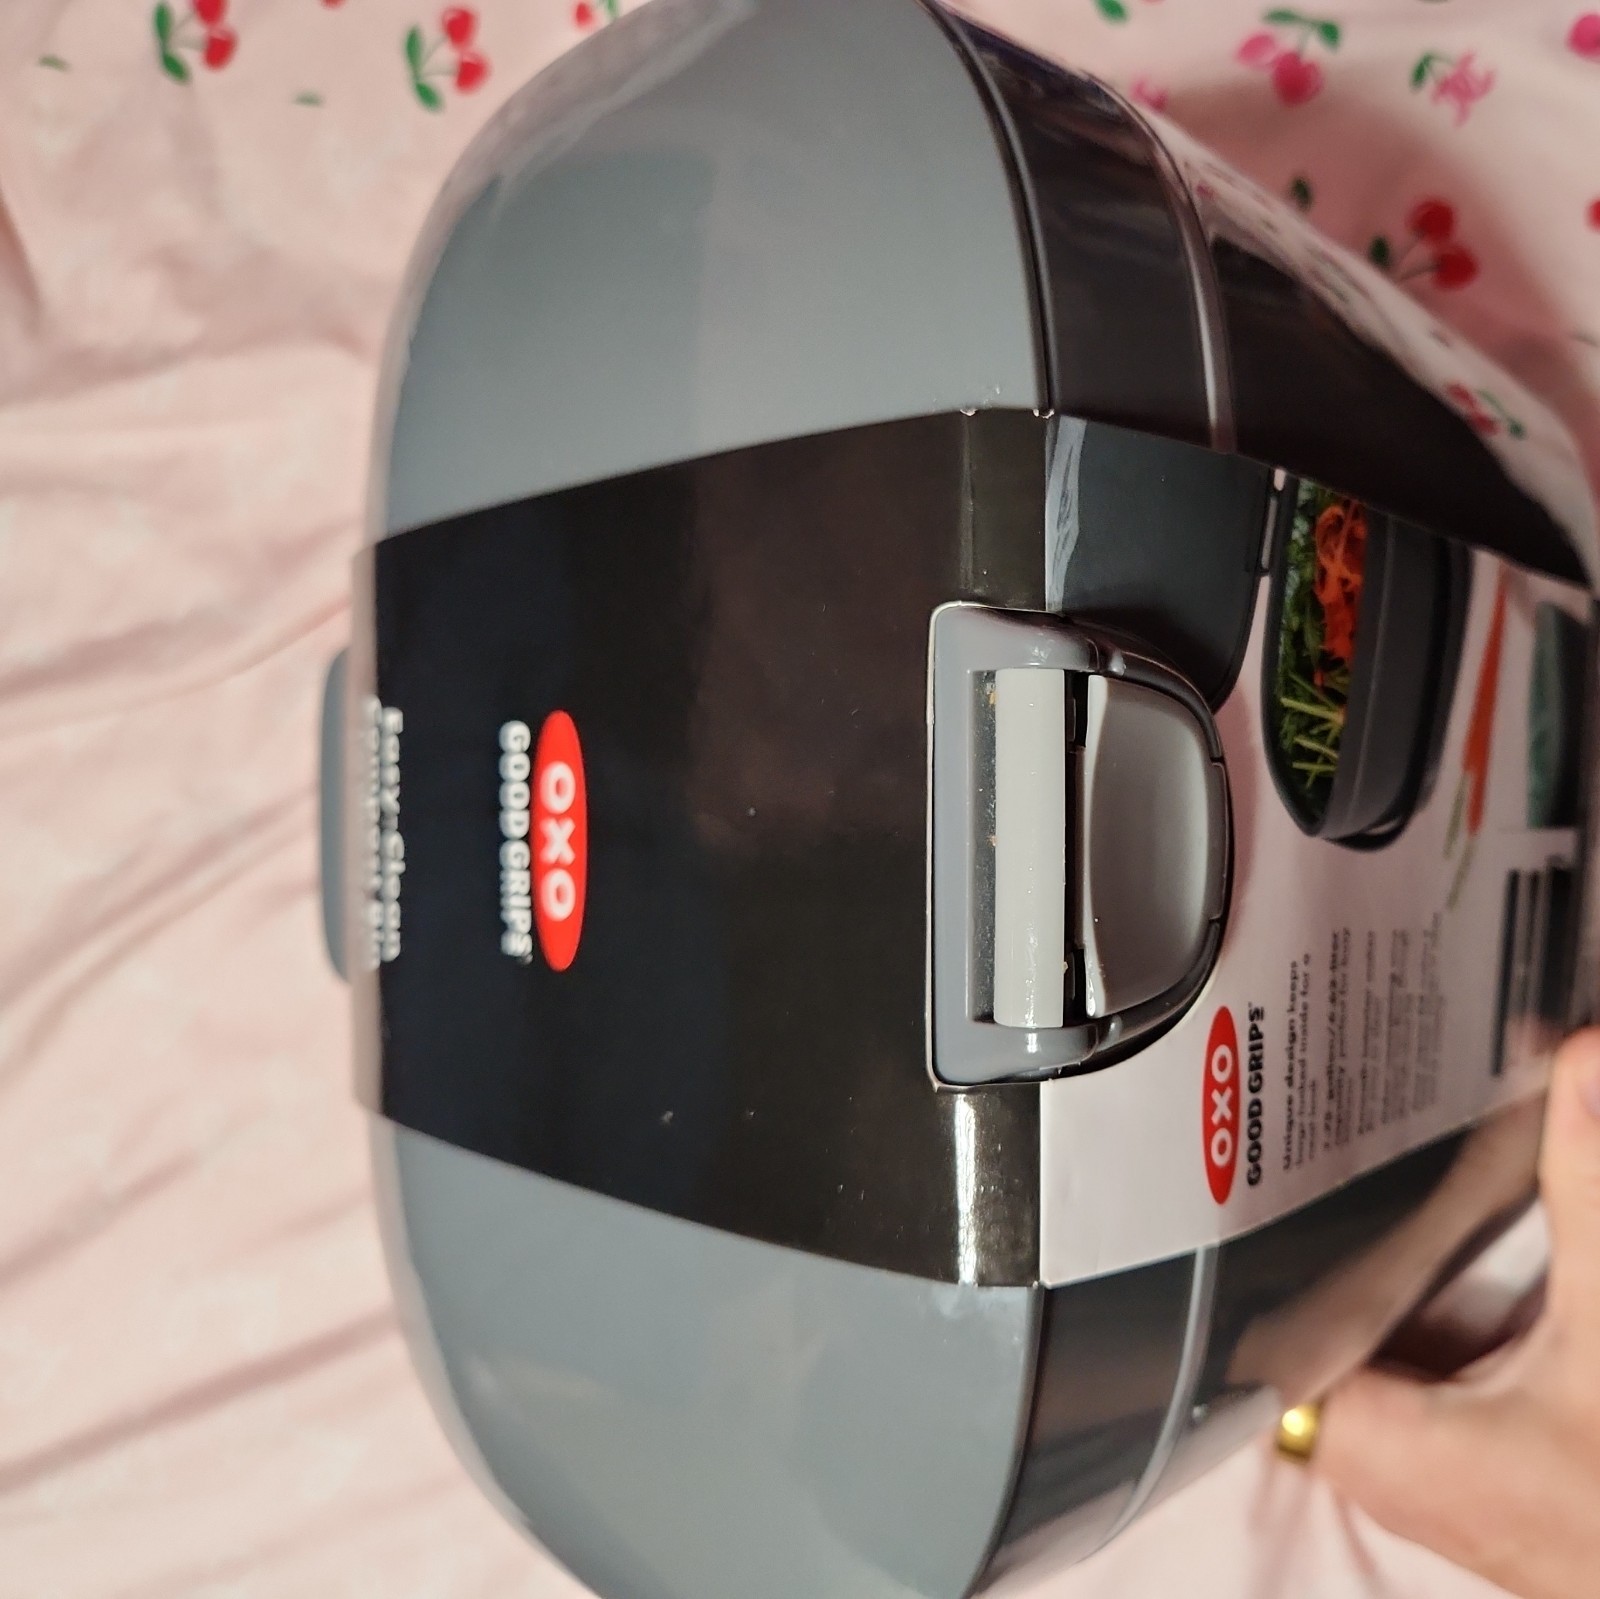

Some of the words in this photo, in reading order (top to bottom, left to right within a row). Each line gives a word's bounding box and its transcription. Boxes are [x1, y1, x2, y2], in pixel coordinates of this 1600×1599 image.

[380, 706, 406, 962] Easy-Clean
[500, 720, 531, 839] GOOD
[501, 840, 533, 957] GRIPS
[540, 761, 576, 922] OXO
[1211, 1044, 1233, 1168] OXO
[1248, 1006, 1264, 1093] GRIPS
[1284, 1019, 1296, 1088] design
[1247, 1098, 1262, 1186] GOOD
